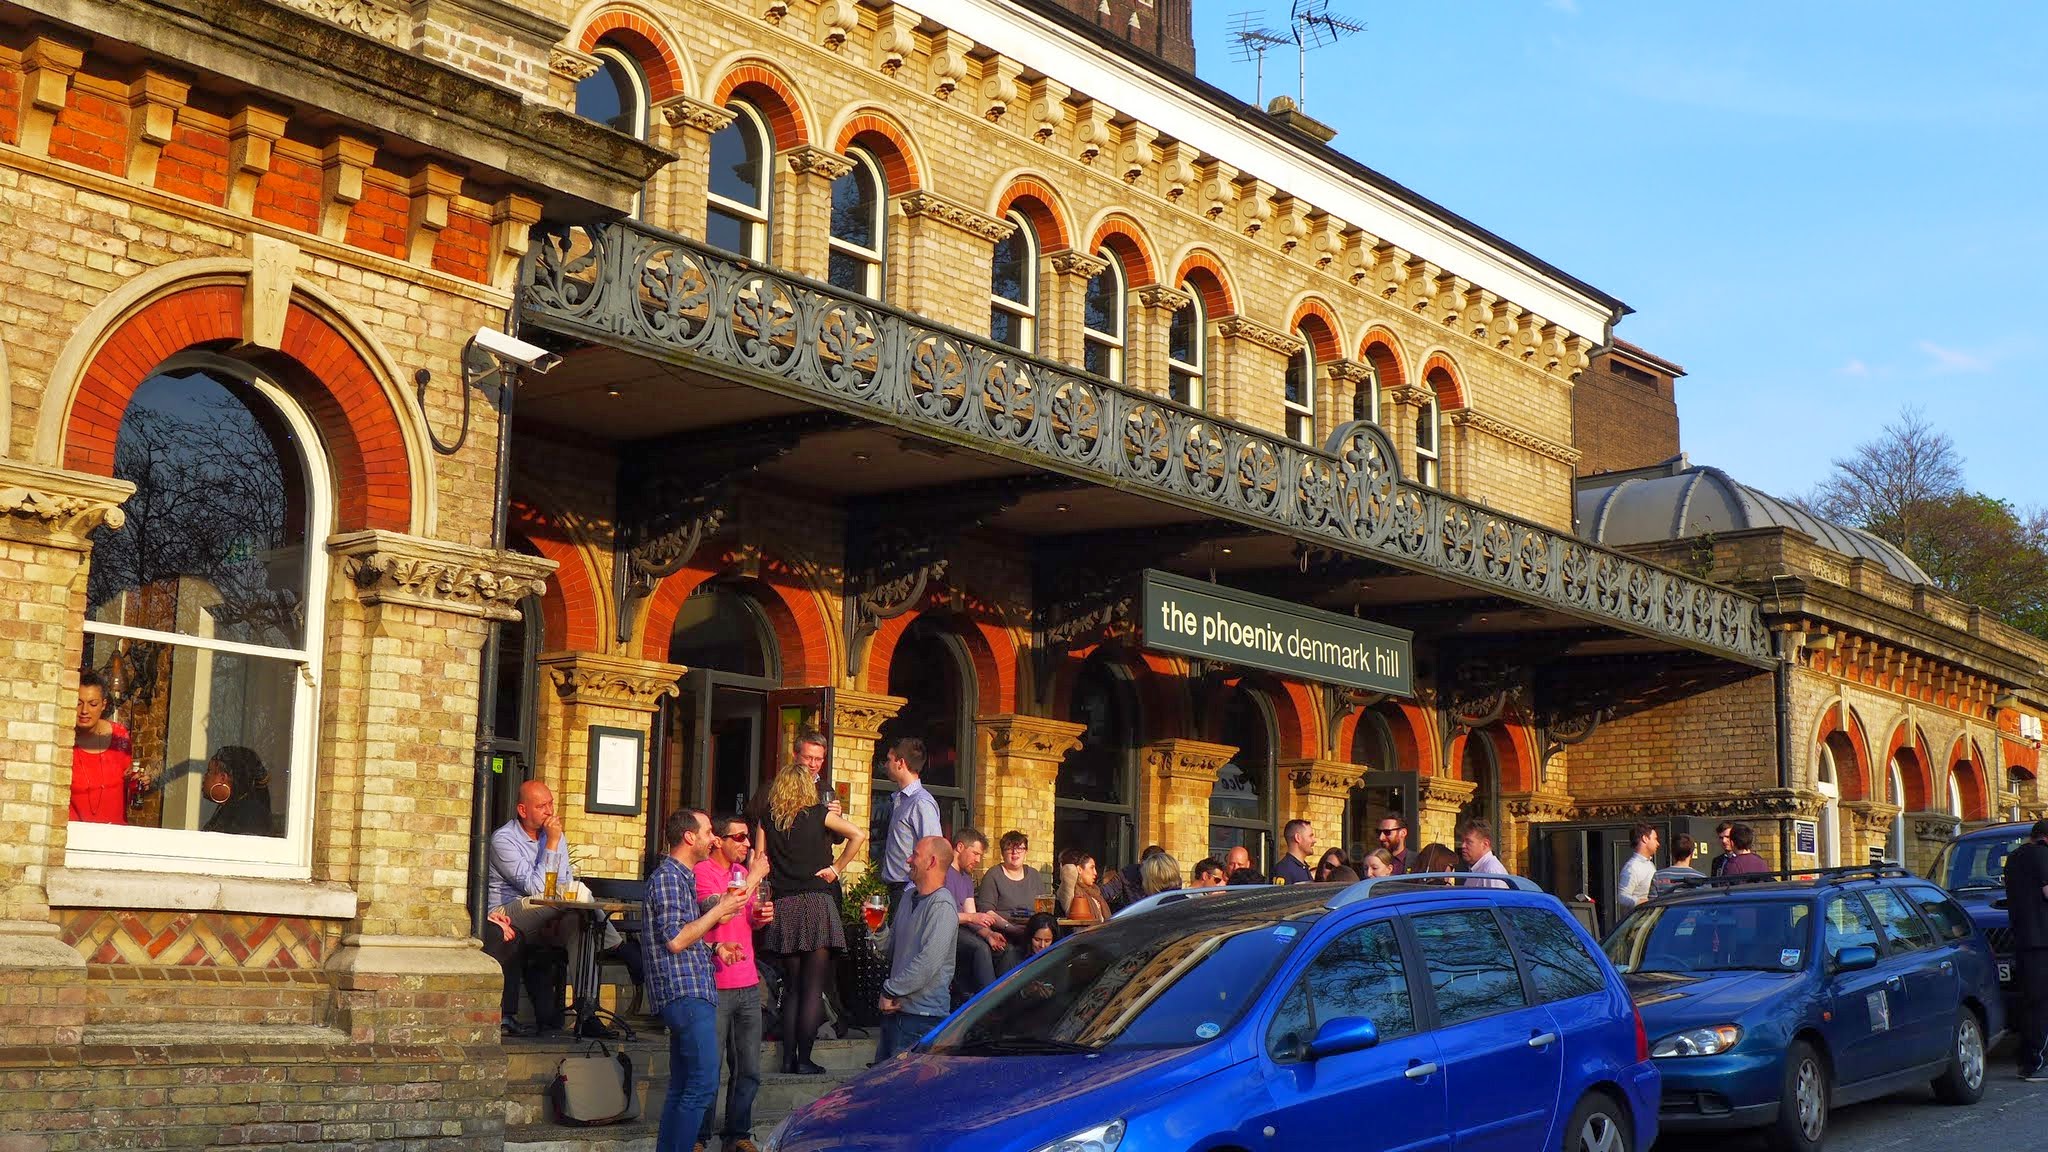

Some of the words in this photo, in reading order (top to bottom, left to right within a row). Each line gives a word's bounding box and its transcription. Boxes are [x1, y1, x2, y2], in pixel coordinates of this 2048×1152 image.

[1161, 601, 1197, 636] the
[1203, 611, 1284, 654] phoenix
[1287, 629, 1371, 672] denmark
[1375, 646, 1399, 678] hill
